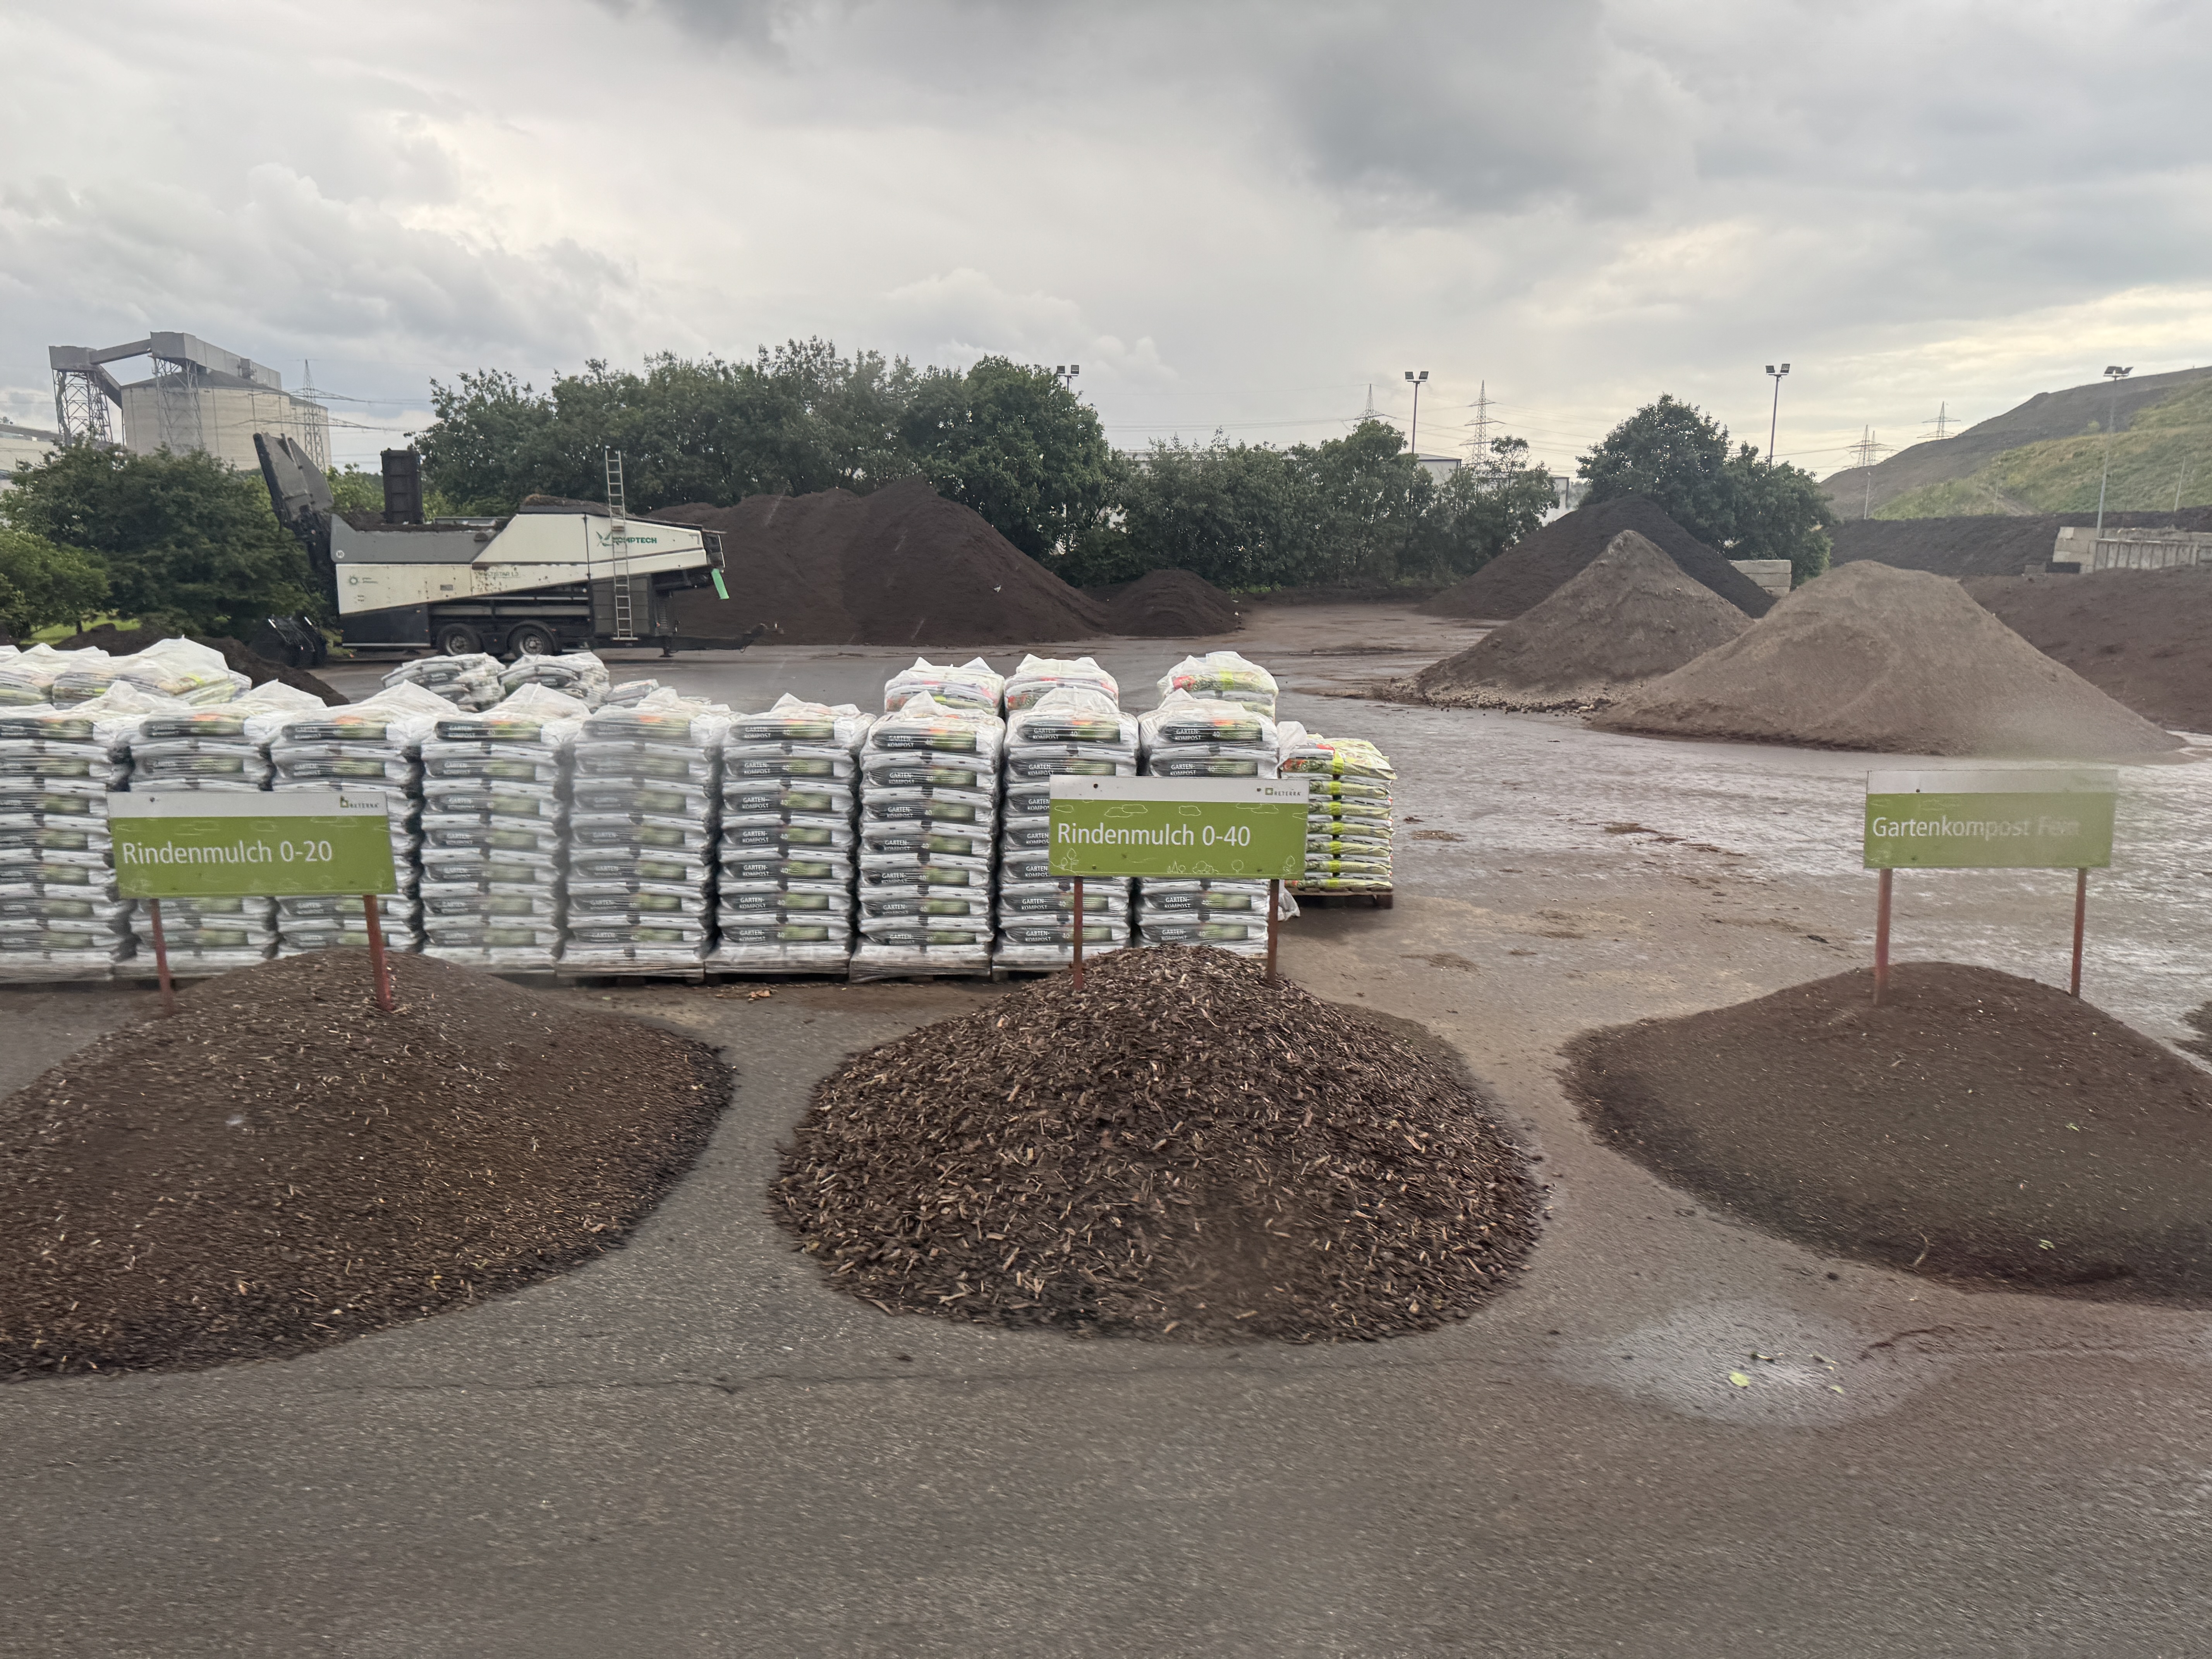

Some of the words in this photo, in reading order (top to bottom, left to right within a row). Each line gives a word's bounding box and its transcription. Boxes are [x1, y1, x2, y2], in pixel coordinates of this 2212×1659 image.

[1058, 822, 1194, 845] Rindenmulch
[1202, 825, 1251, 846] 0-40
[1873, 815, 2029, 841] Gartenkompost
[122, 839, 272, 864] Rindenmulch
[280, 840, 333, 862] 0-20
